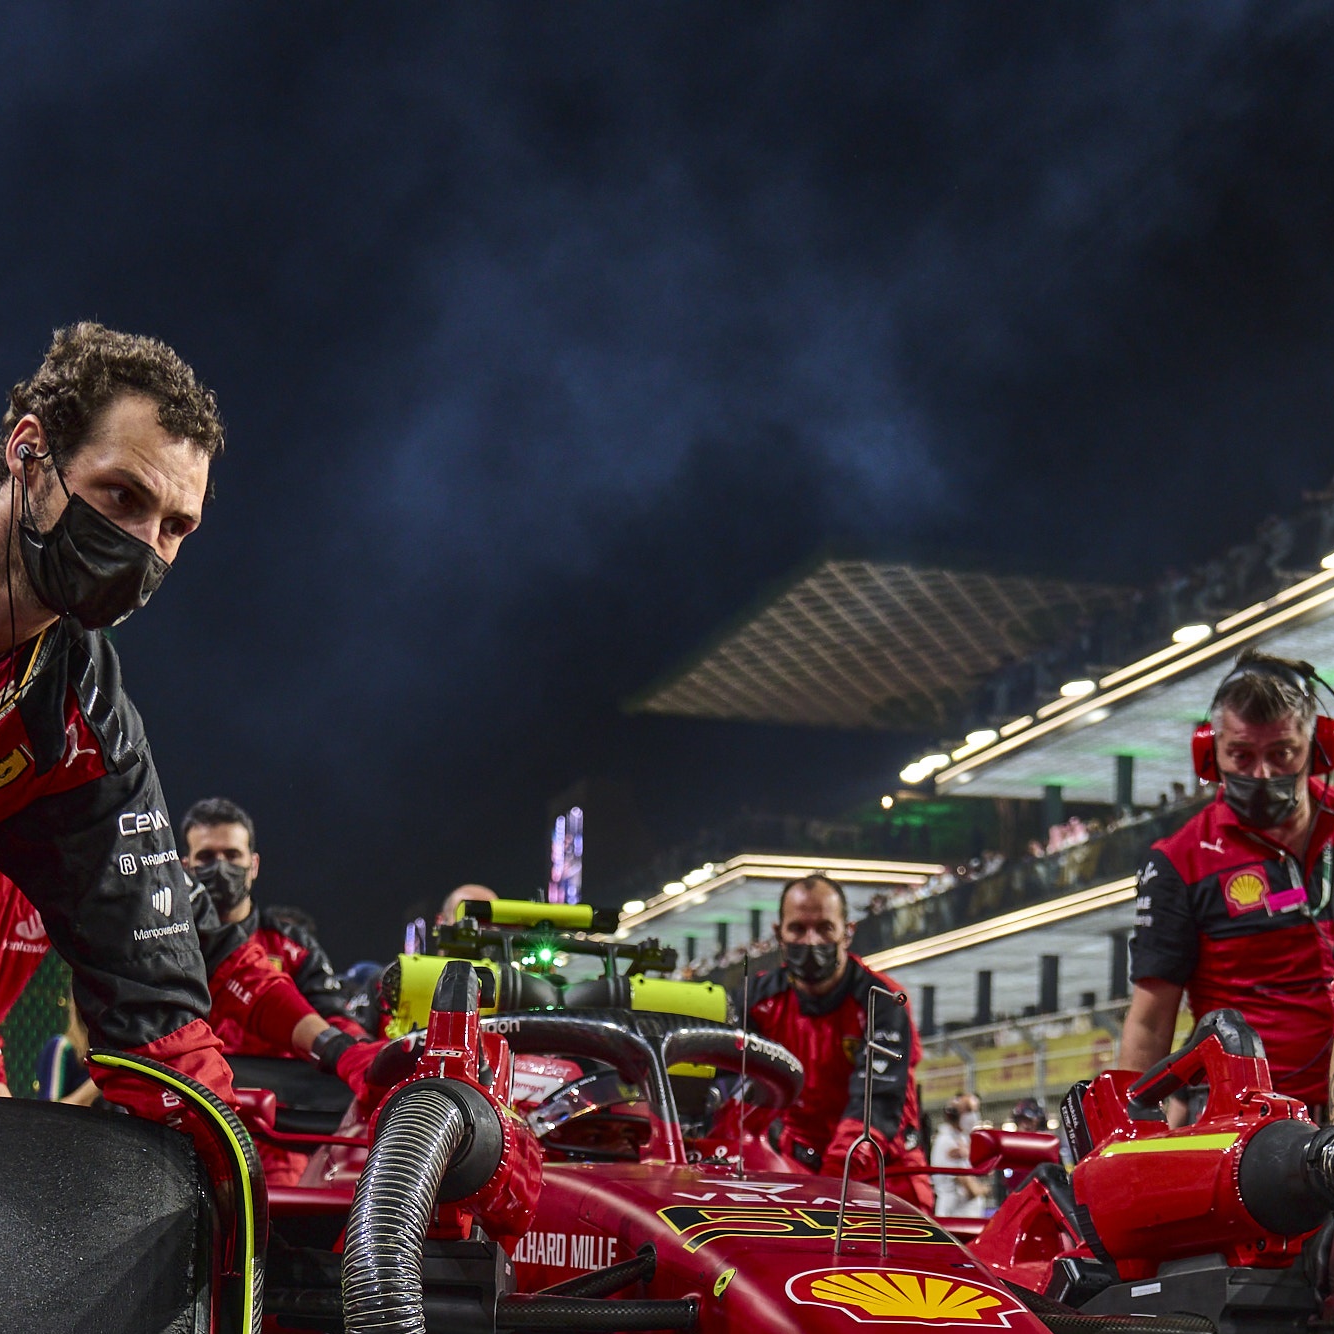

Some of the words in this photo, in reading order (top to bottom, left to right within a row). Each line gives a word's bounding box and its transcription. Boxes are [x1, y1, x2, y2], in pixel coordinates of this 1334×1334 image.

[672, 1192, 893, 1209] VELAS
[656, 1205, 960, 1253] 55
[570, 1234, 618, 1271] MILLE
